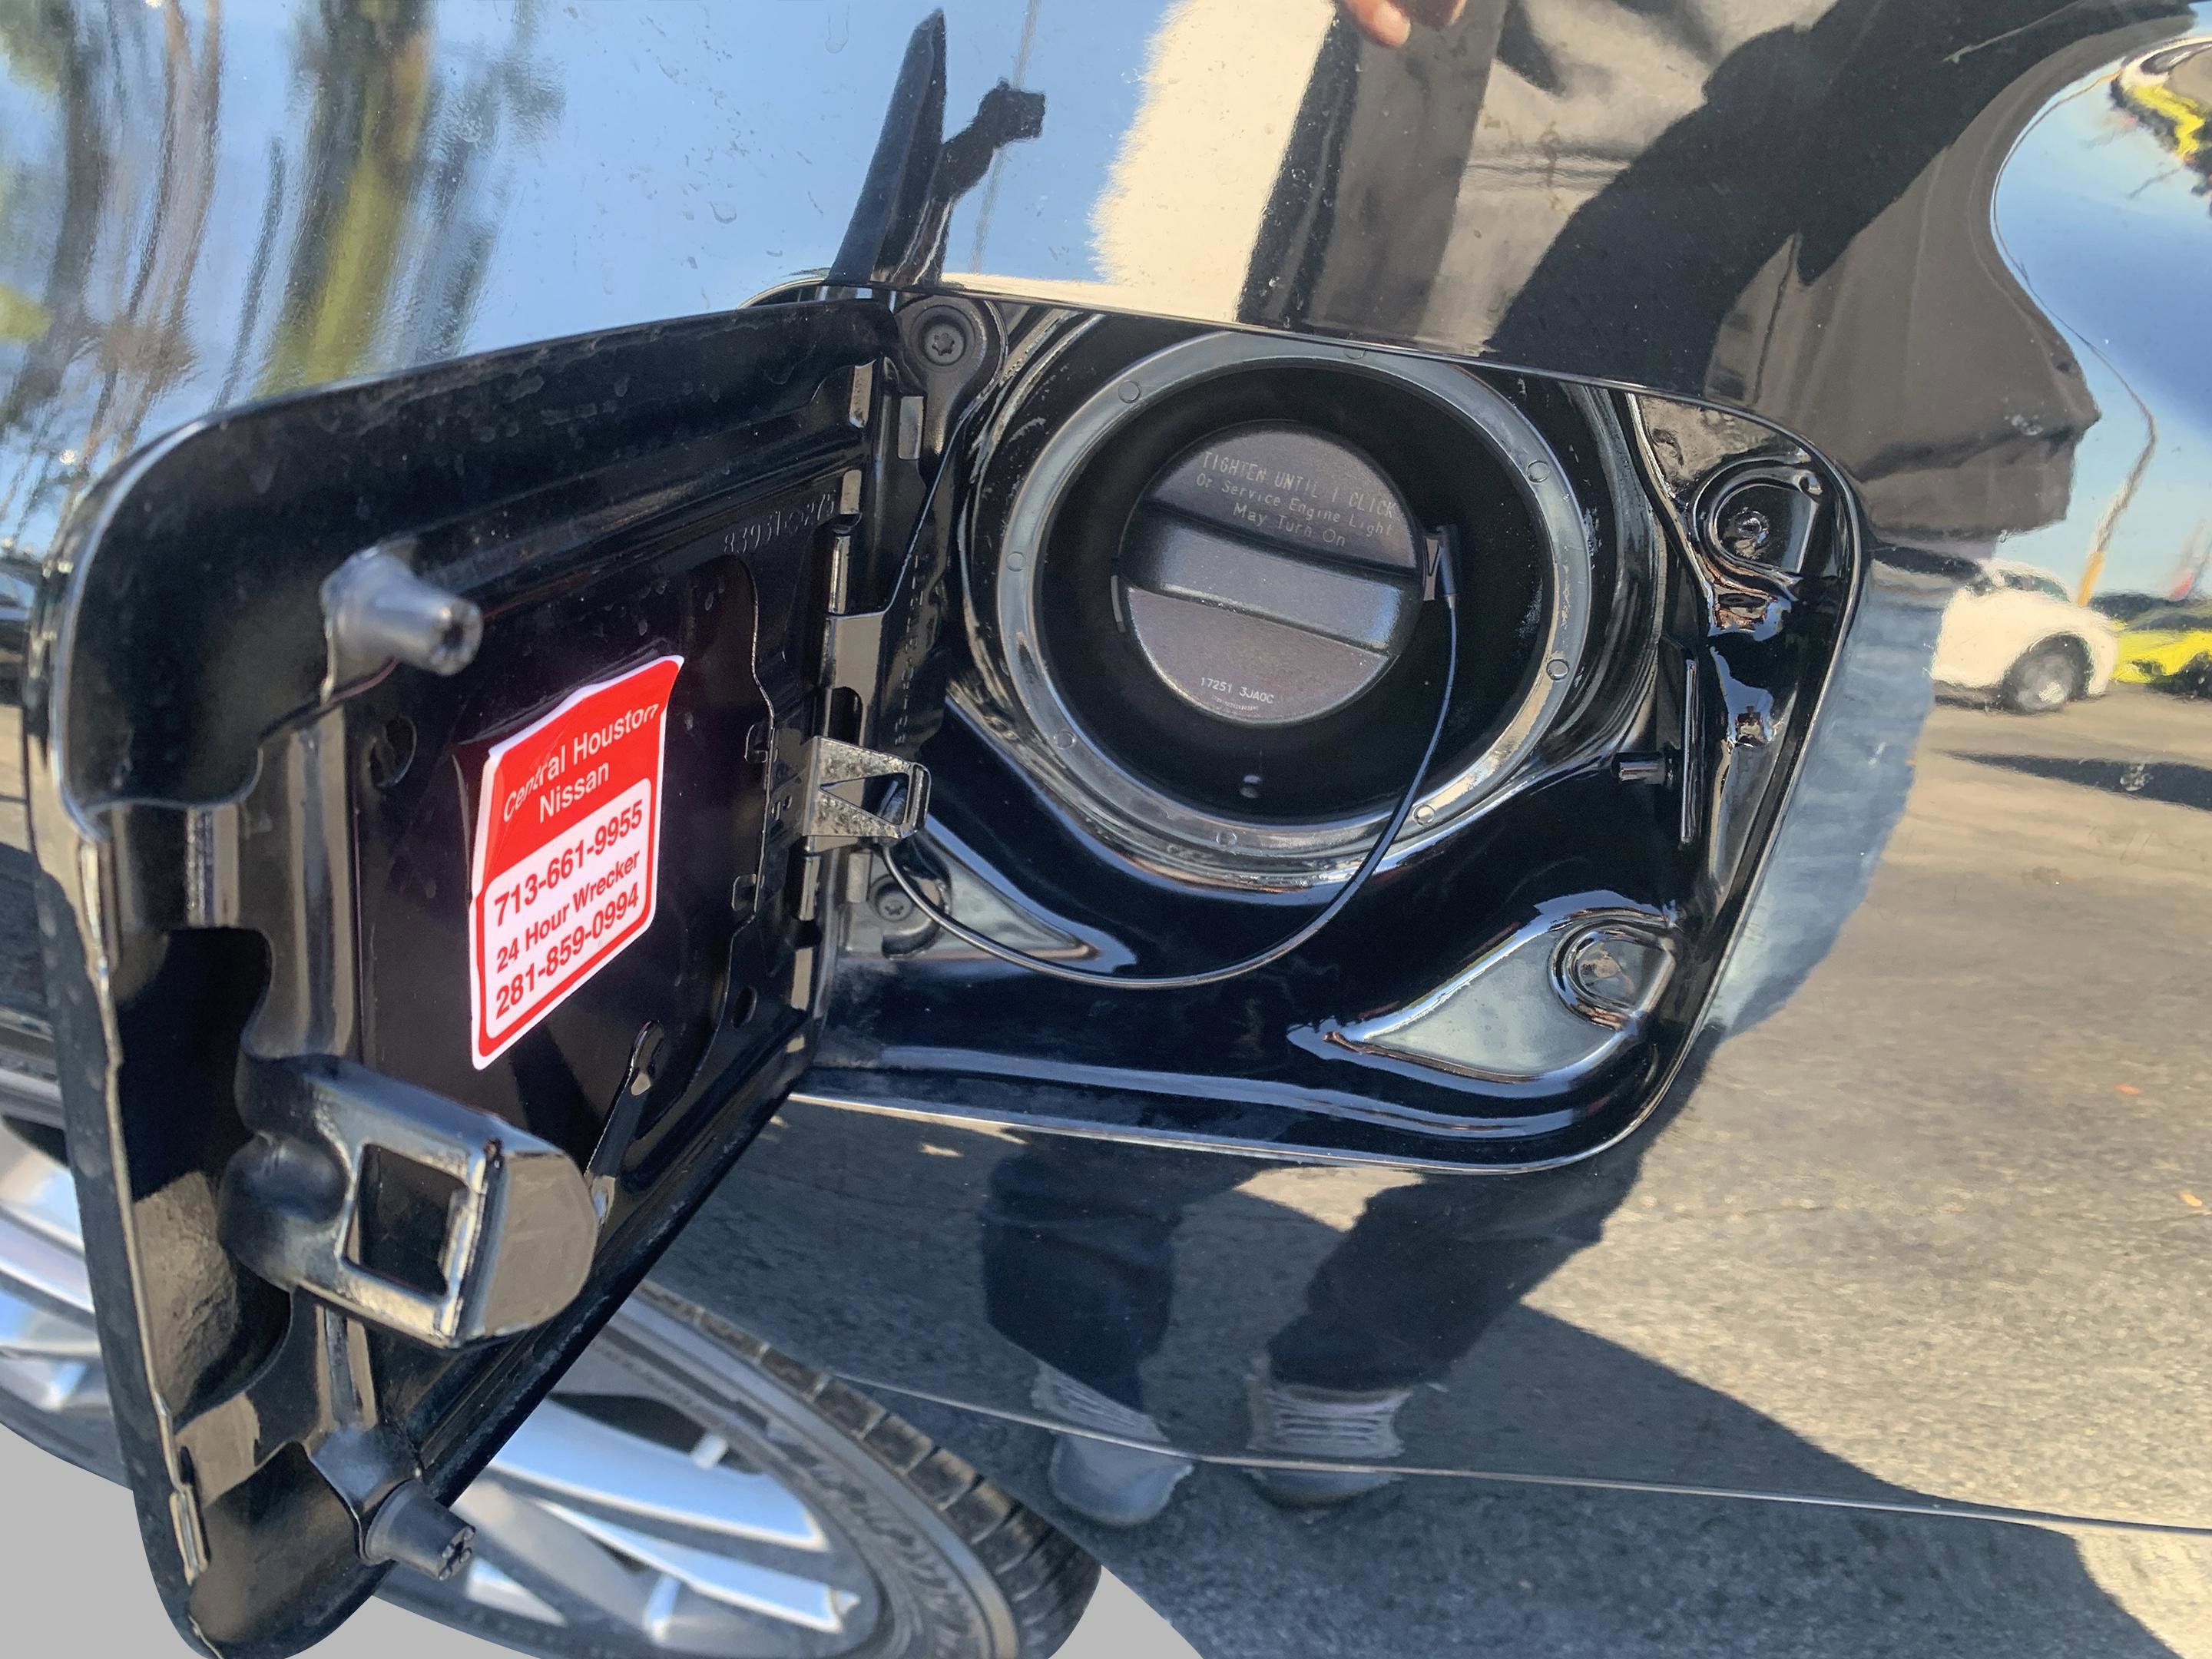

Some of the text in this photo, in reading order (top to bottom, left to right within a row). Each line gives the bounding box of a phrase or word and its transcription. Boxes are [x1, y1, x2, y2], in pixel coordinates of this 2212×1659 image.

[1196, 472, 1392, 537] Or Service Engine Light
[1203, 451, 1267, 482] TIGHTEN
[1274, 472, 1319, 498] UNTIL
[1349, 492, 1397, 518] CLICK
[1233, 502, 1346, 547] May Turn On
[1200, 677, 1233, 694] 17251
[502, 704, 659, 823] Central Houston
[539, 762, 610, 823] Nissan
[494, 798, 644, 927] 713-661-9955
[496, 849, 641, 974] 24 Hour Wrecker
[495, 881, 640, 1020] 281-859-0994
